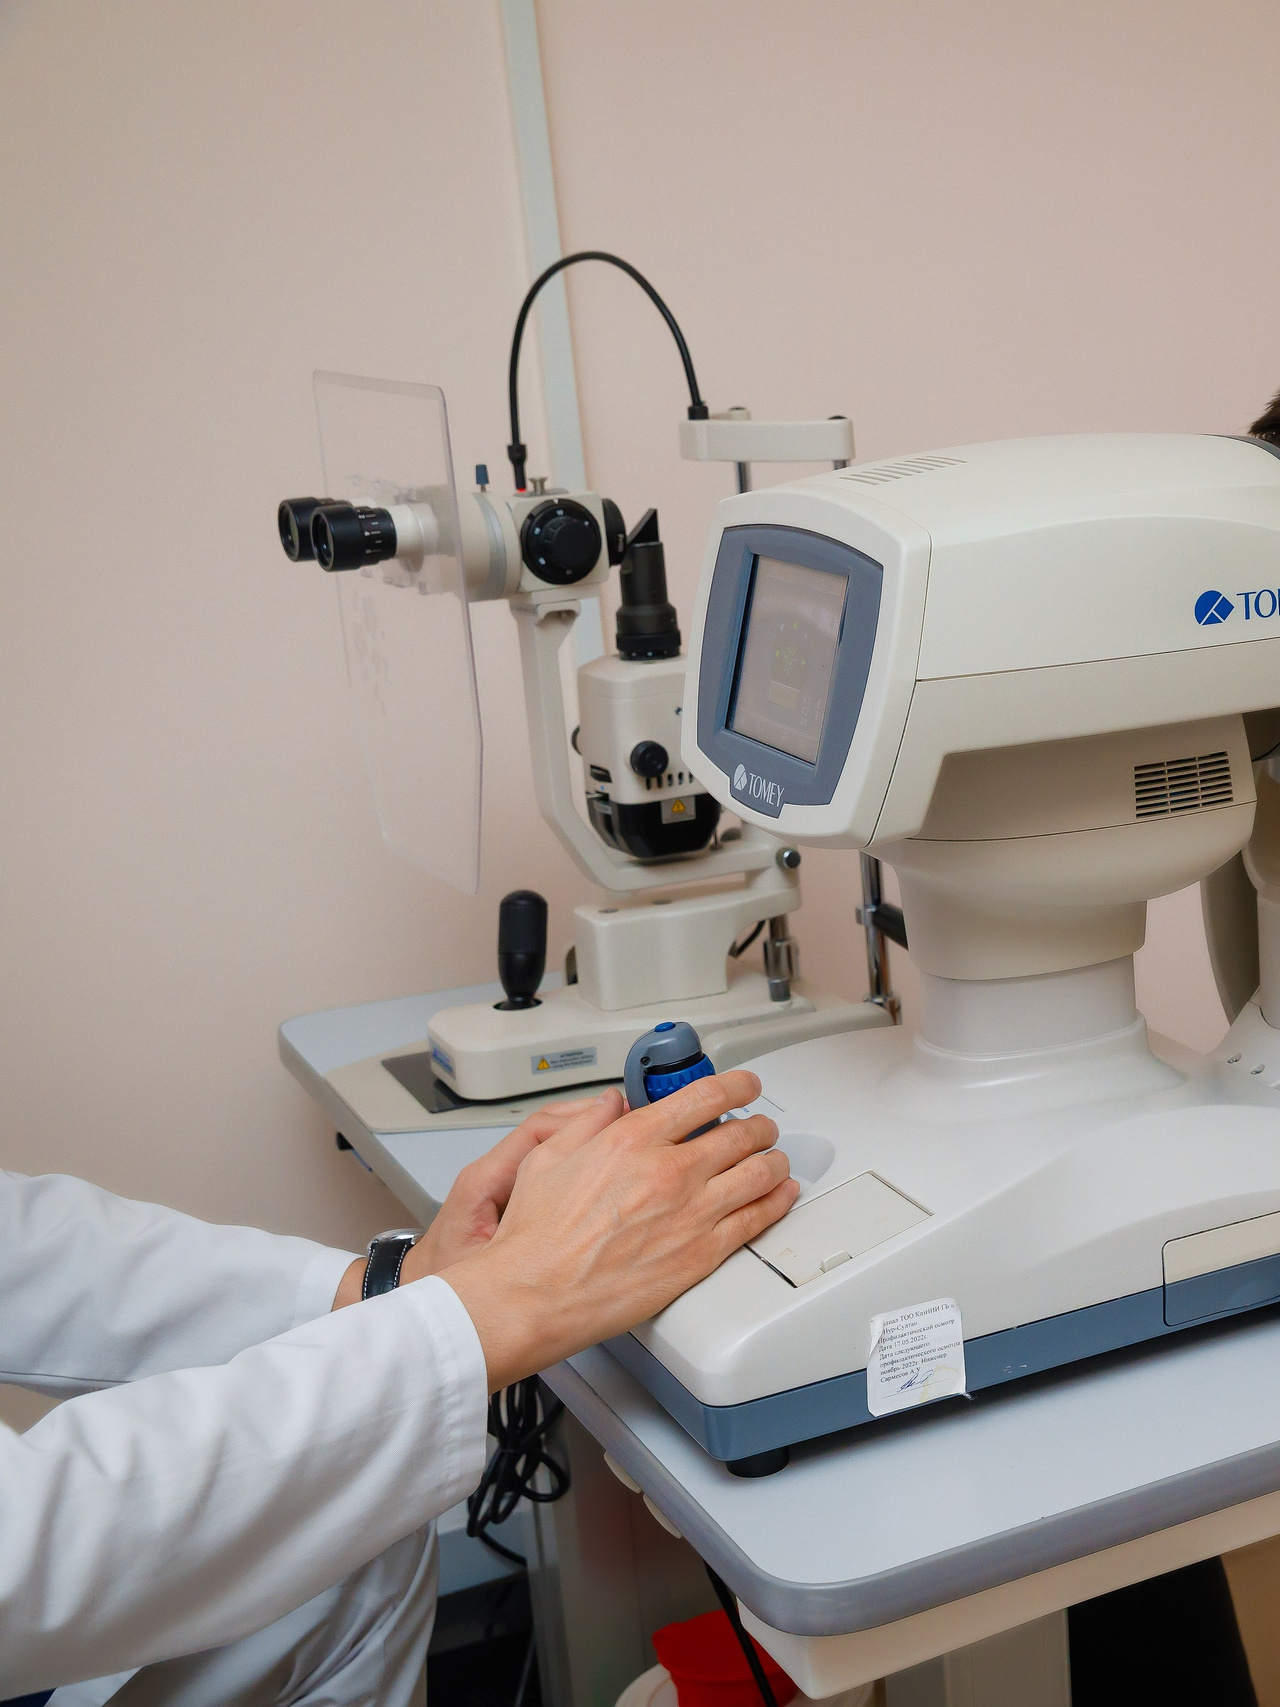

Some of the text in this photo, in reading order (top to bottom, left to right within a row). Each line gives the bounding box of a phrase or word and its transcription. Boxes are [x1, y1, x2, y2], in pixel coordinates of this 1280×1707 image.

[748, 772, 785, 808] TOMEY
[900, 1313, 915, 1323] ТОО
[878, 1318, 955, 1344] Профилактический осмотр
[878, 1344, 893, 1353] Дата
[879, 1342, 931, 1362] Дата следующего
[880, 1341, 961, 1369] профилактического осмотра
[880, 1365, 901, 1376] ноябрь
[921, 1352, 947, 1364] Инженер
